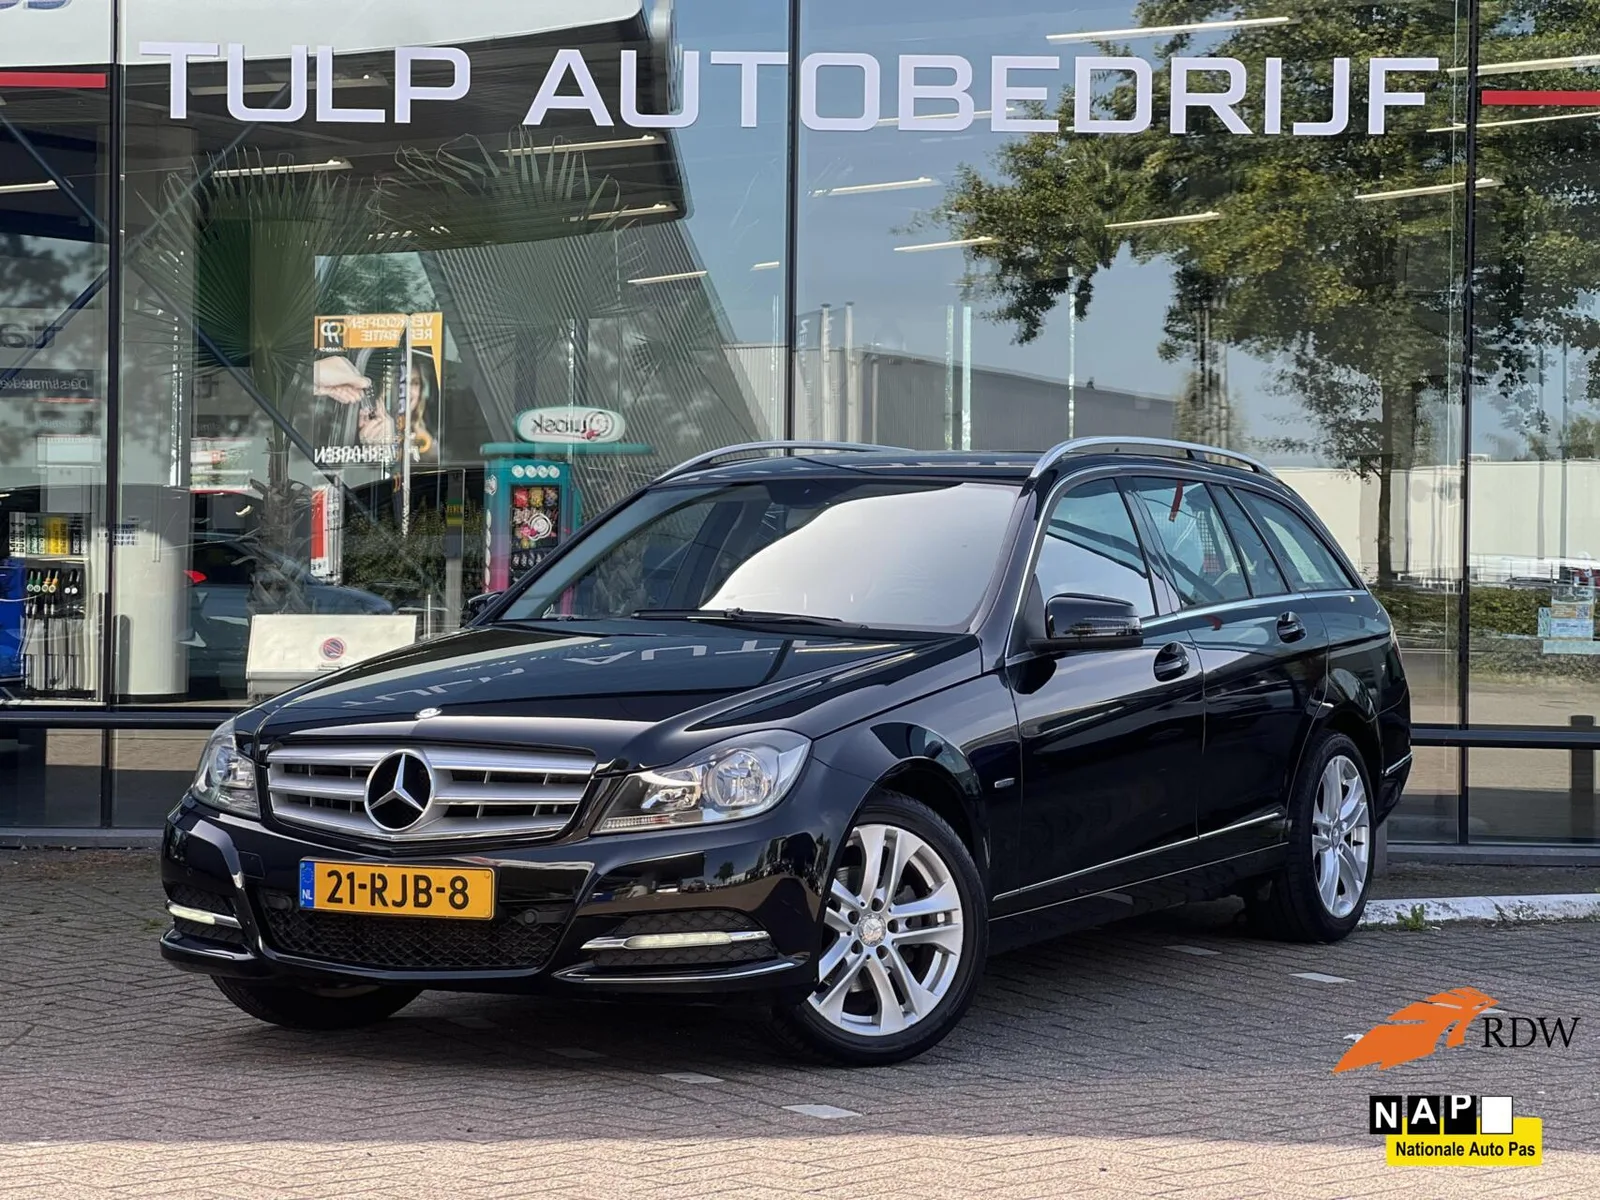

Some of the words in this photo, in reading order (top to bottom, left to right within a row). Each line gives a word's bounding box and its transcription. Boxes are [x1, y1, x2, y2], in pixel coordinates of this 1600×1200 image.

[139, 41, 471, 124] TULP
[522, 48, 1440, 136] AUTOBEDRIJF
[302, 889, 313, 900] NL
[326, 869, 469, 910] 21-RJB-8
